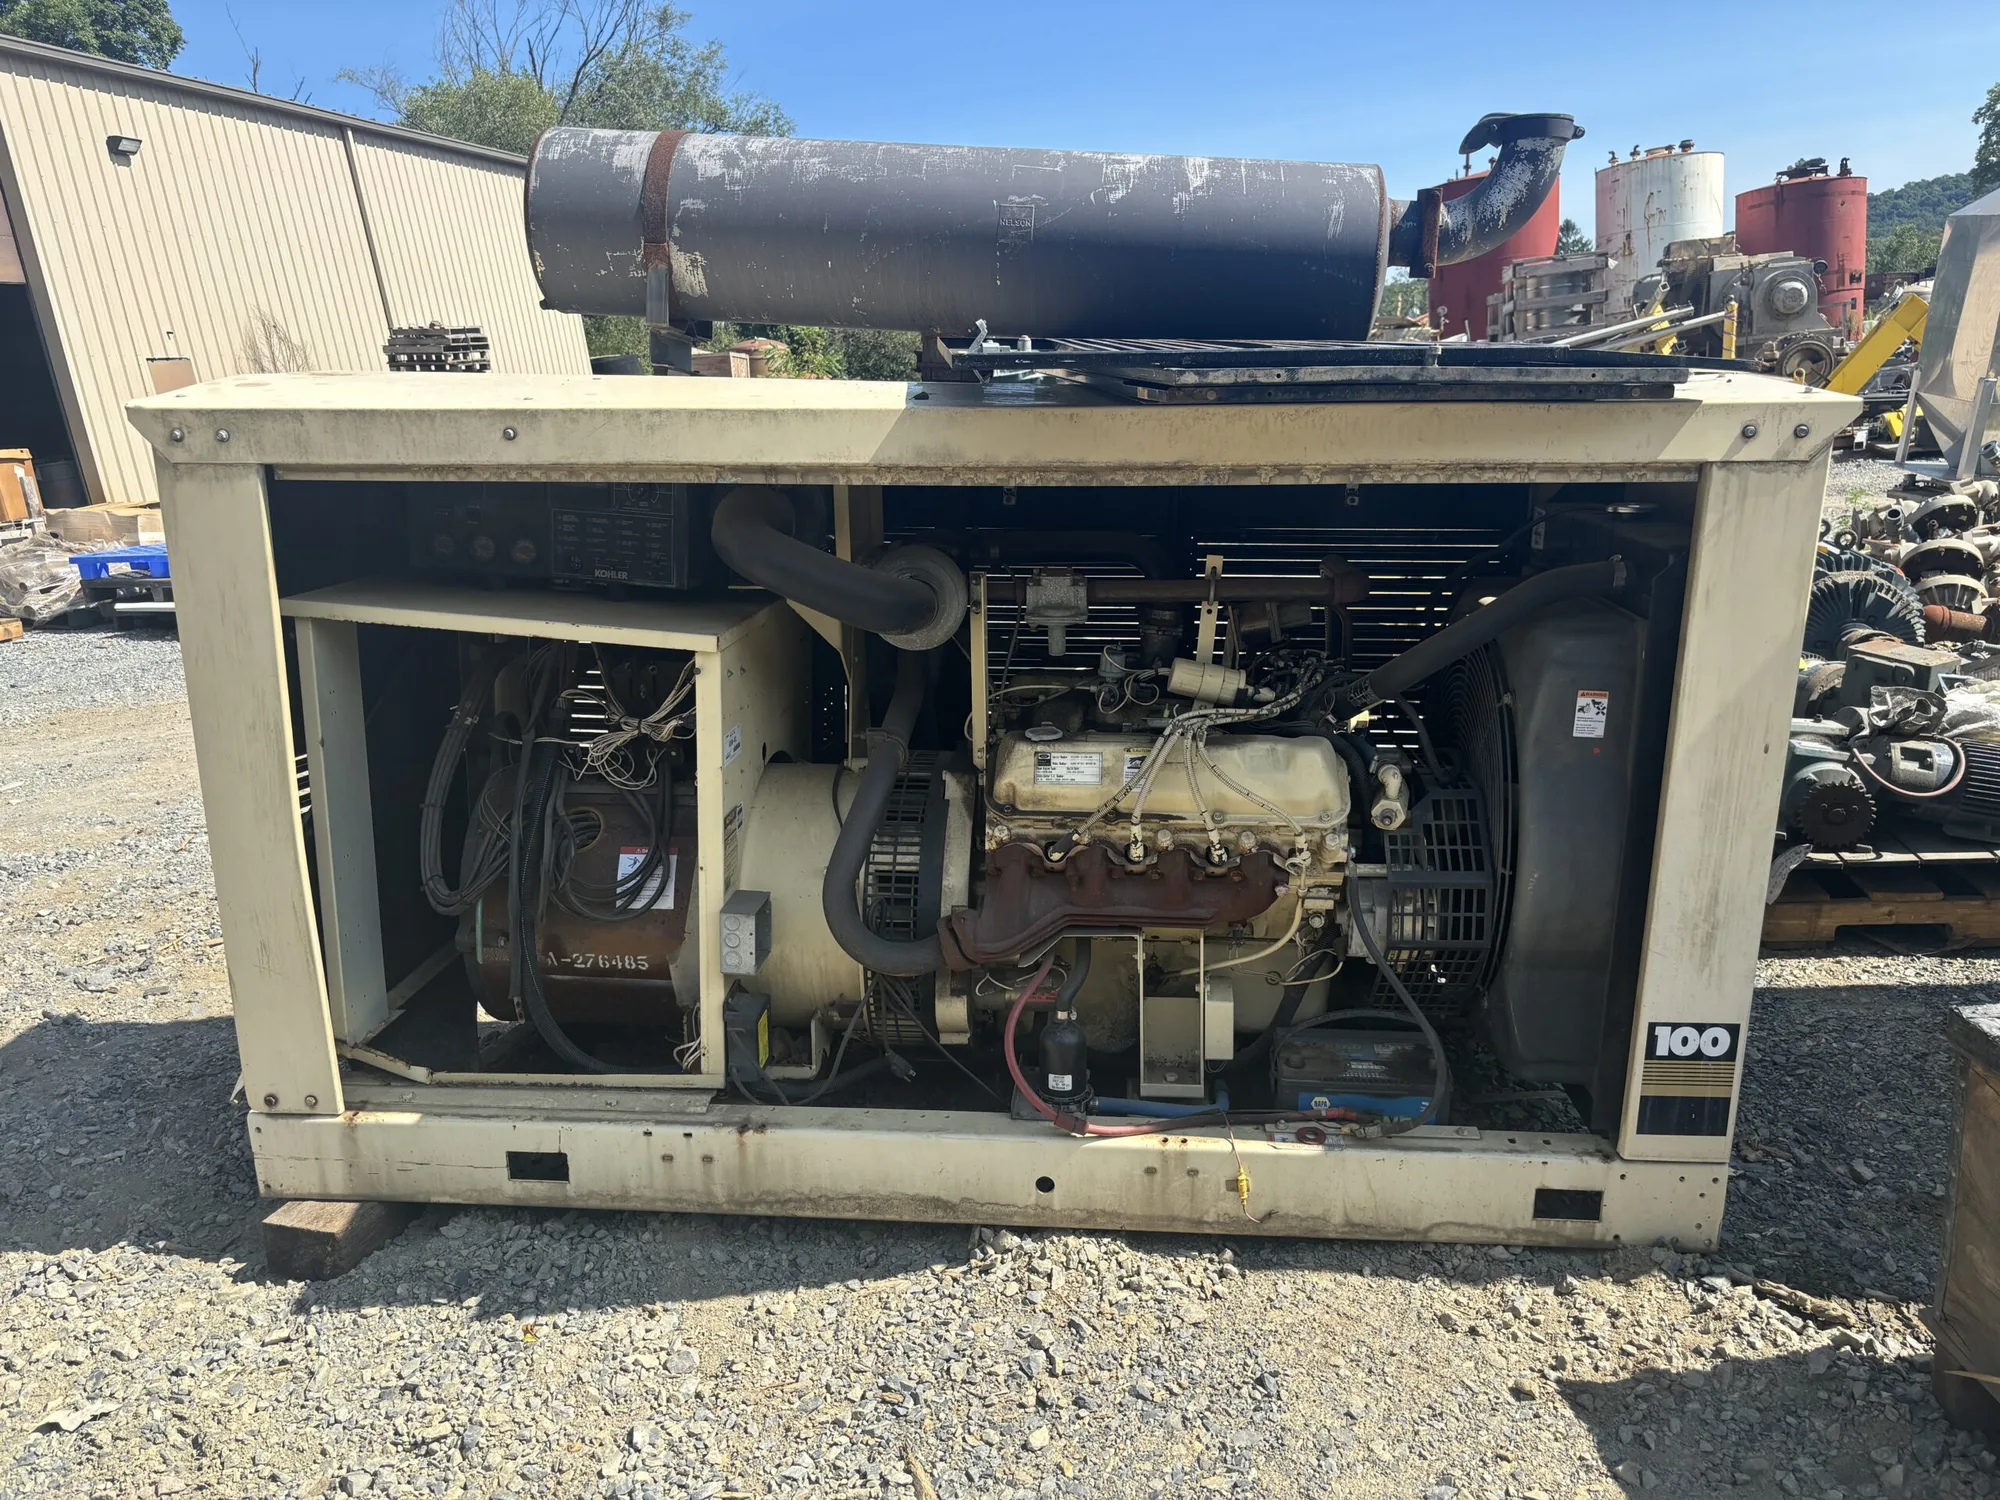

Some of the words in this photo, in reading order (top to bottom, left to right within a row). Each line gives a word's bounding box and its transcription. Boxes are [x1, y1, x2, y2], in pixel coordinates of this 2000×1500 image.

[1000, 218, 1031, 227] NELSON
[595, 569, 628, 580] KOHLER
[1654, 1026, 1731, 1057] 100
[1314, 1100, 1328, 1108] NAPA
